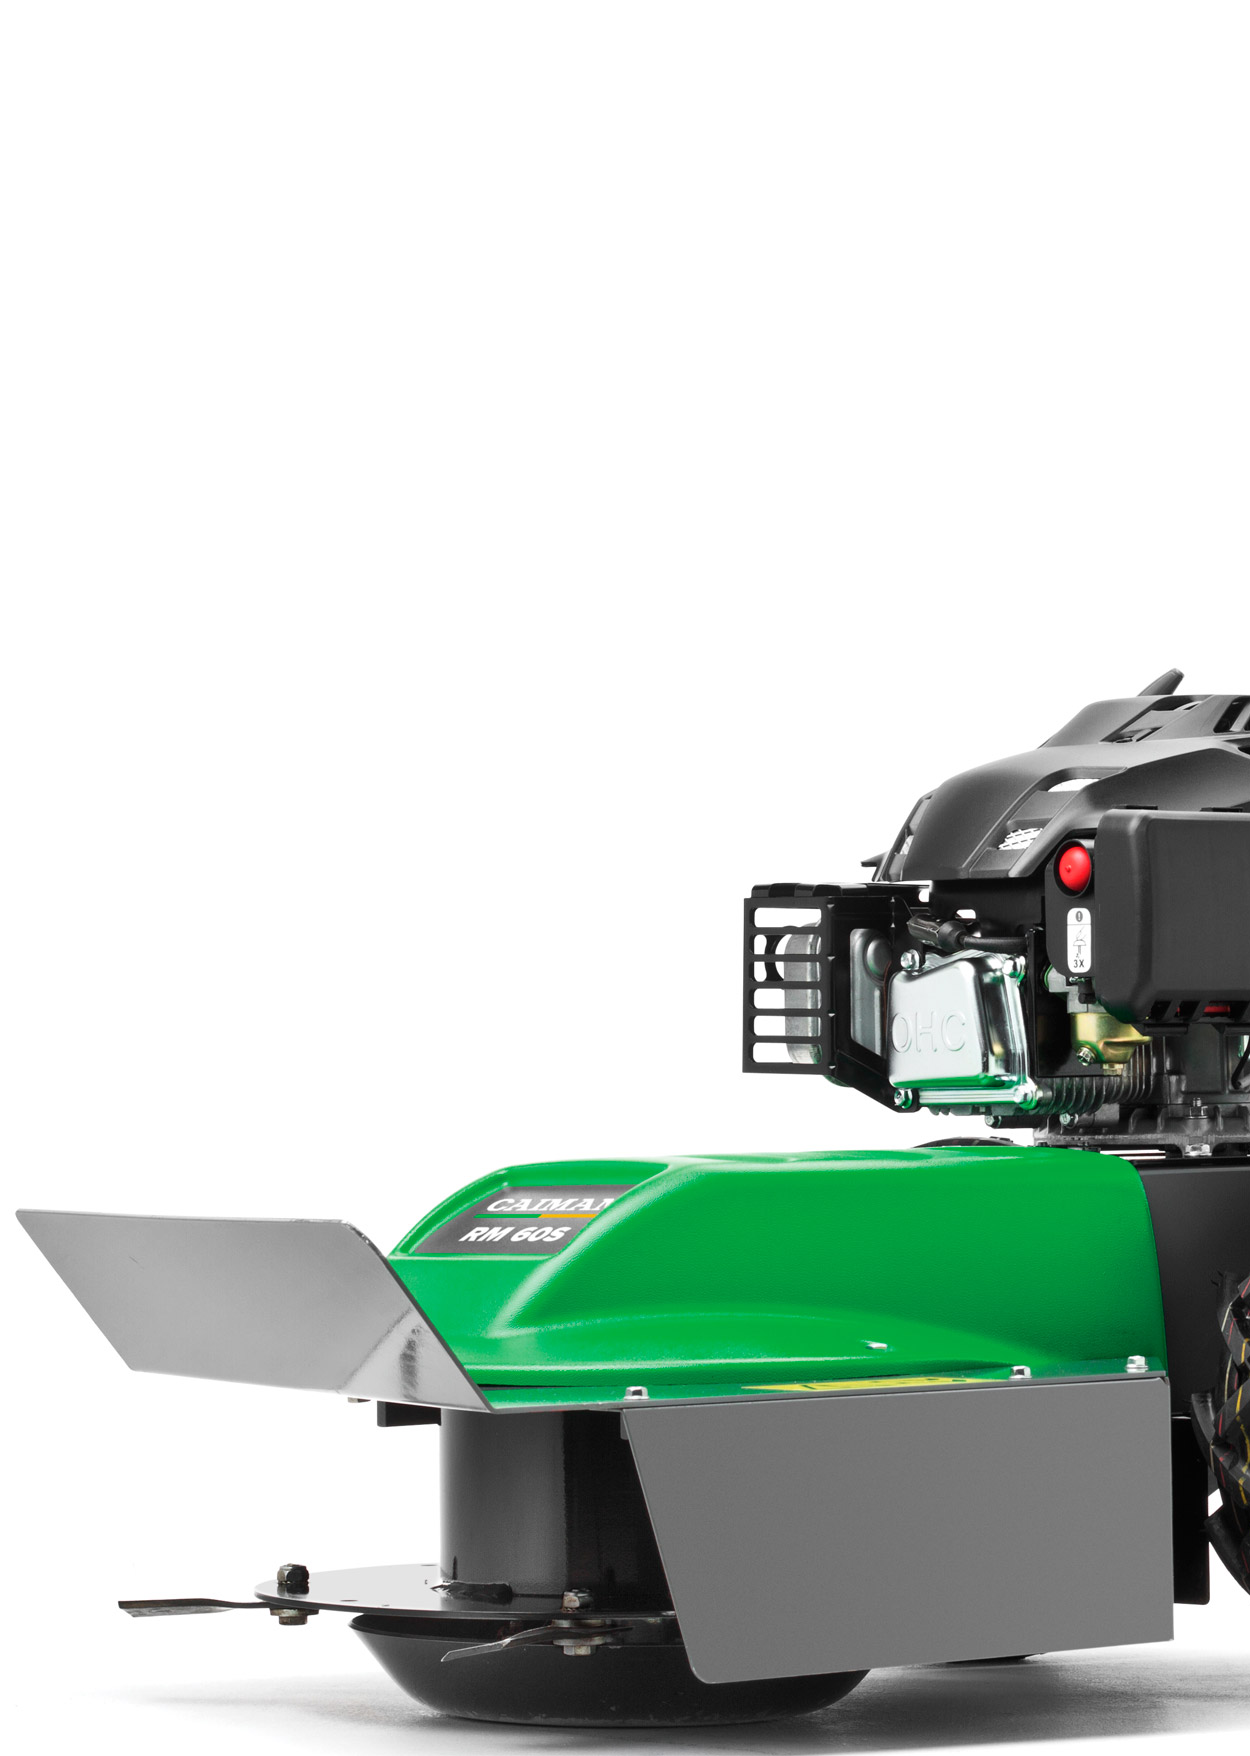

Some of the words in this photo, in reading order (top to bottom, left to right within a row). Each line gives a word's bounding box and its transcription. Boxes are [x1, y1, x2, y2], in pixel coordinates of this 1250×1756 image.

[891, 1010, 967, 1054] OHC
[458, 1226, 510, 1242] RM
[510, 1226, 572, 1242] 60S
